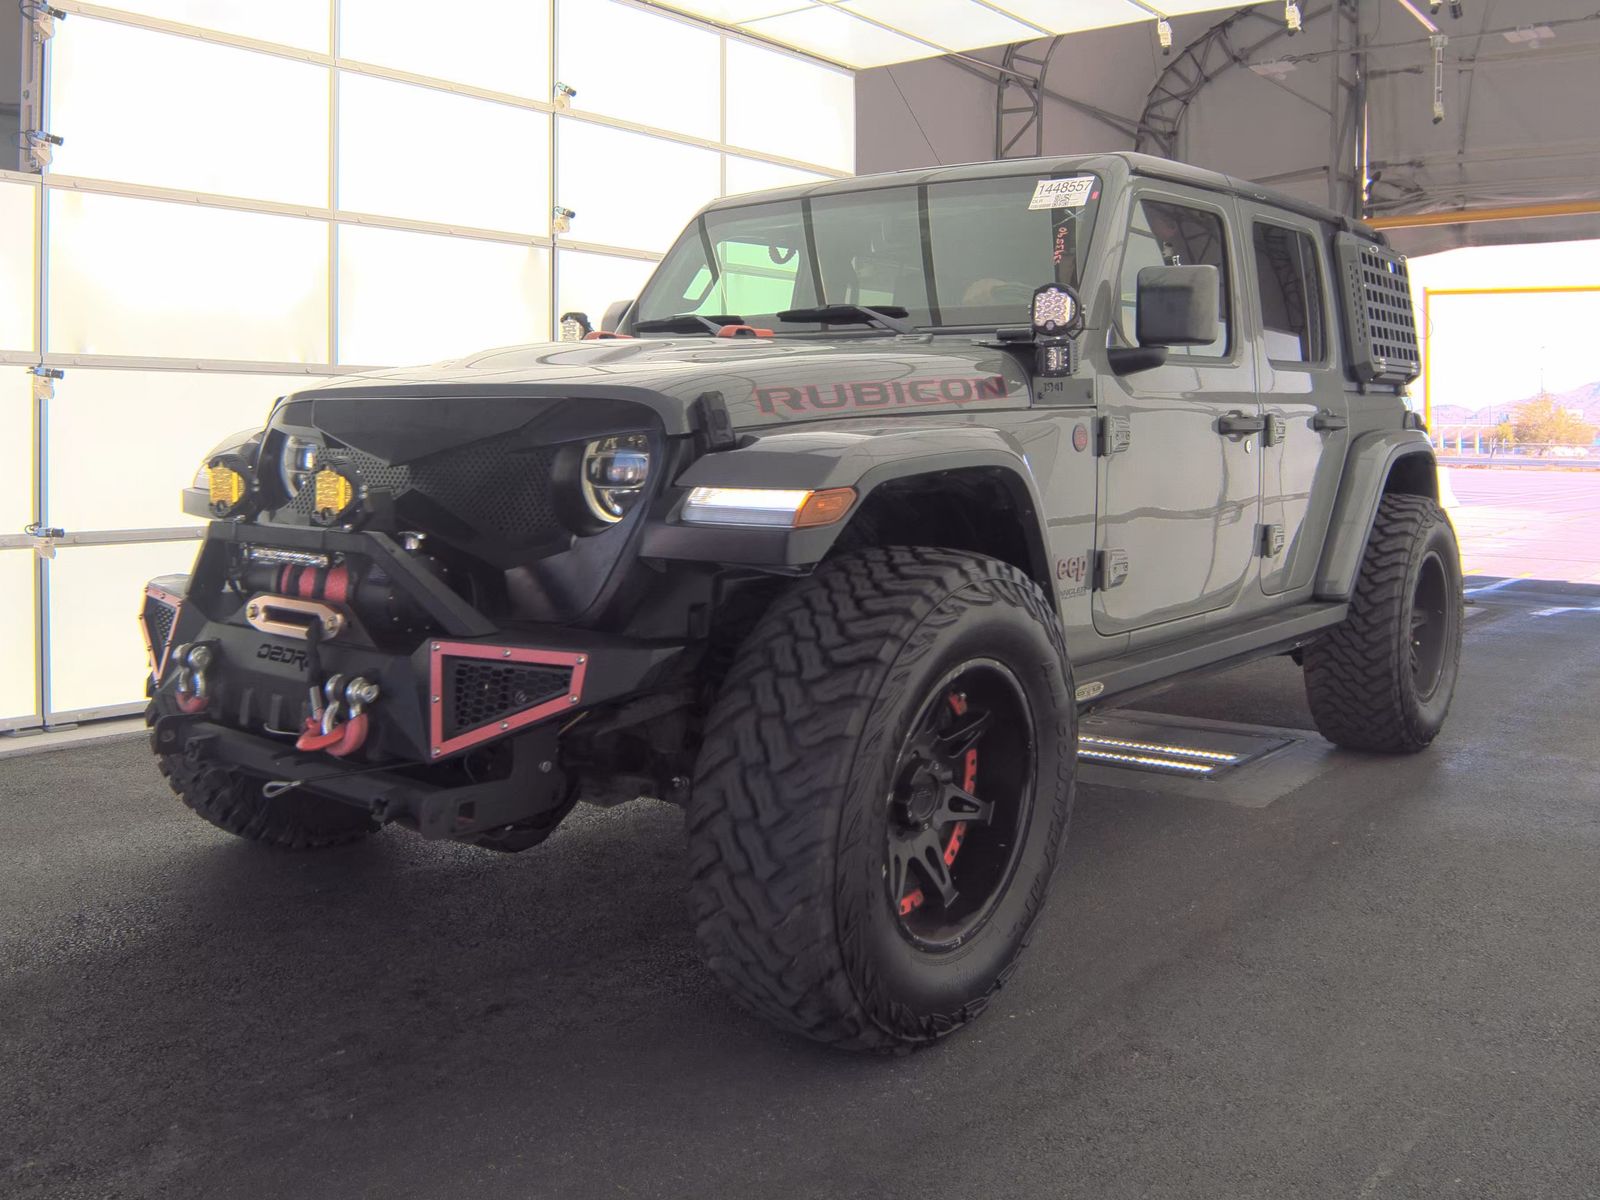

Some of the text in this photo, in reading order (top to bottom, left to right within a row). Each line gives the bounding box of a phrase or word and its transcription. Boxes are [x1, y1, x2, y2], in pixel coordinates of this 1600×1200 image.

[1038, 180, 1094, 195] 1448557
[755, 374, 1008, 415] RUBICON
[1054, 554, 1087, 582] eep
[256, 643, 309, 672] OEDR
